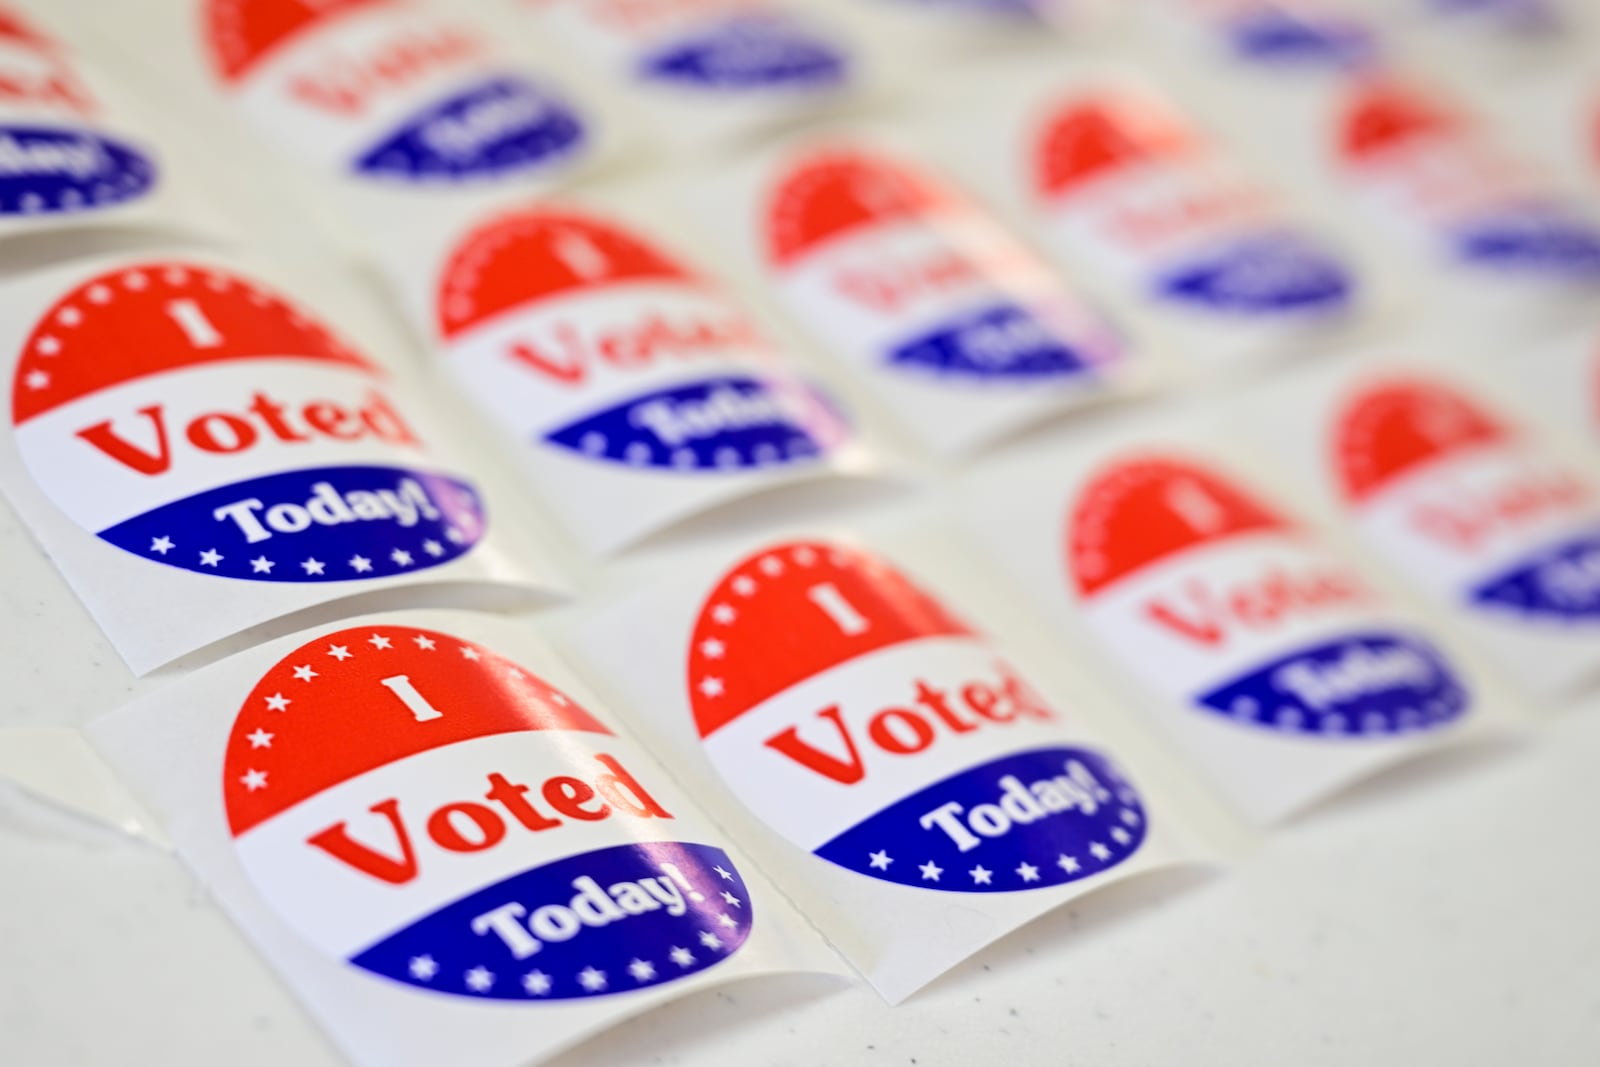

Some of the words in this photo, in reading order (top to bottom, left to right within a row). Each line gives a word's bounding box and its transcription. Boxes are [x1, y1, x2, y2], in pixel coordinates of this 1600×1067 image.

[167, 299, 224, 348] I
[75, 387, 424, 476] Voted
[214, 478, 441, 543] Today!
[807, 583, 870, 635] I
[381, 675, 443, 722] I
[306, 753, 676, 887] Voted
[920, 760, 1111, 853] Today!
[471, 863, 705, 960] Today!
